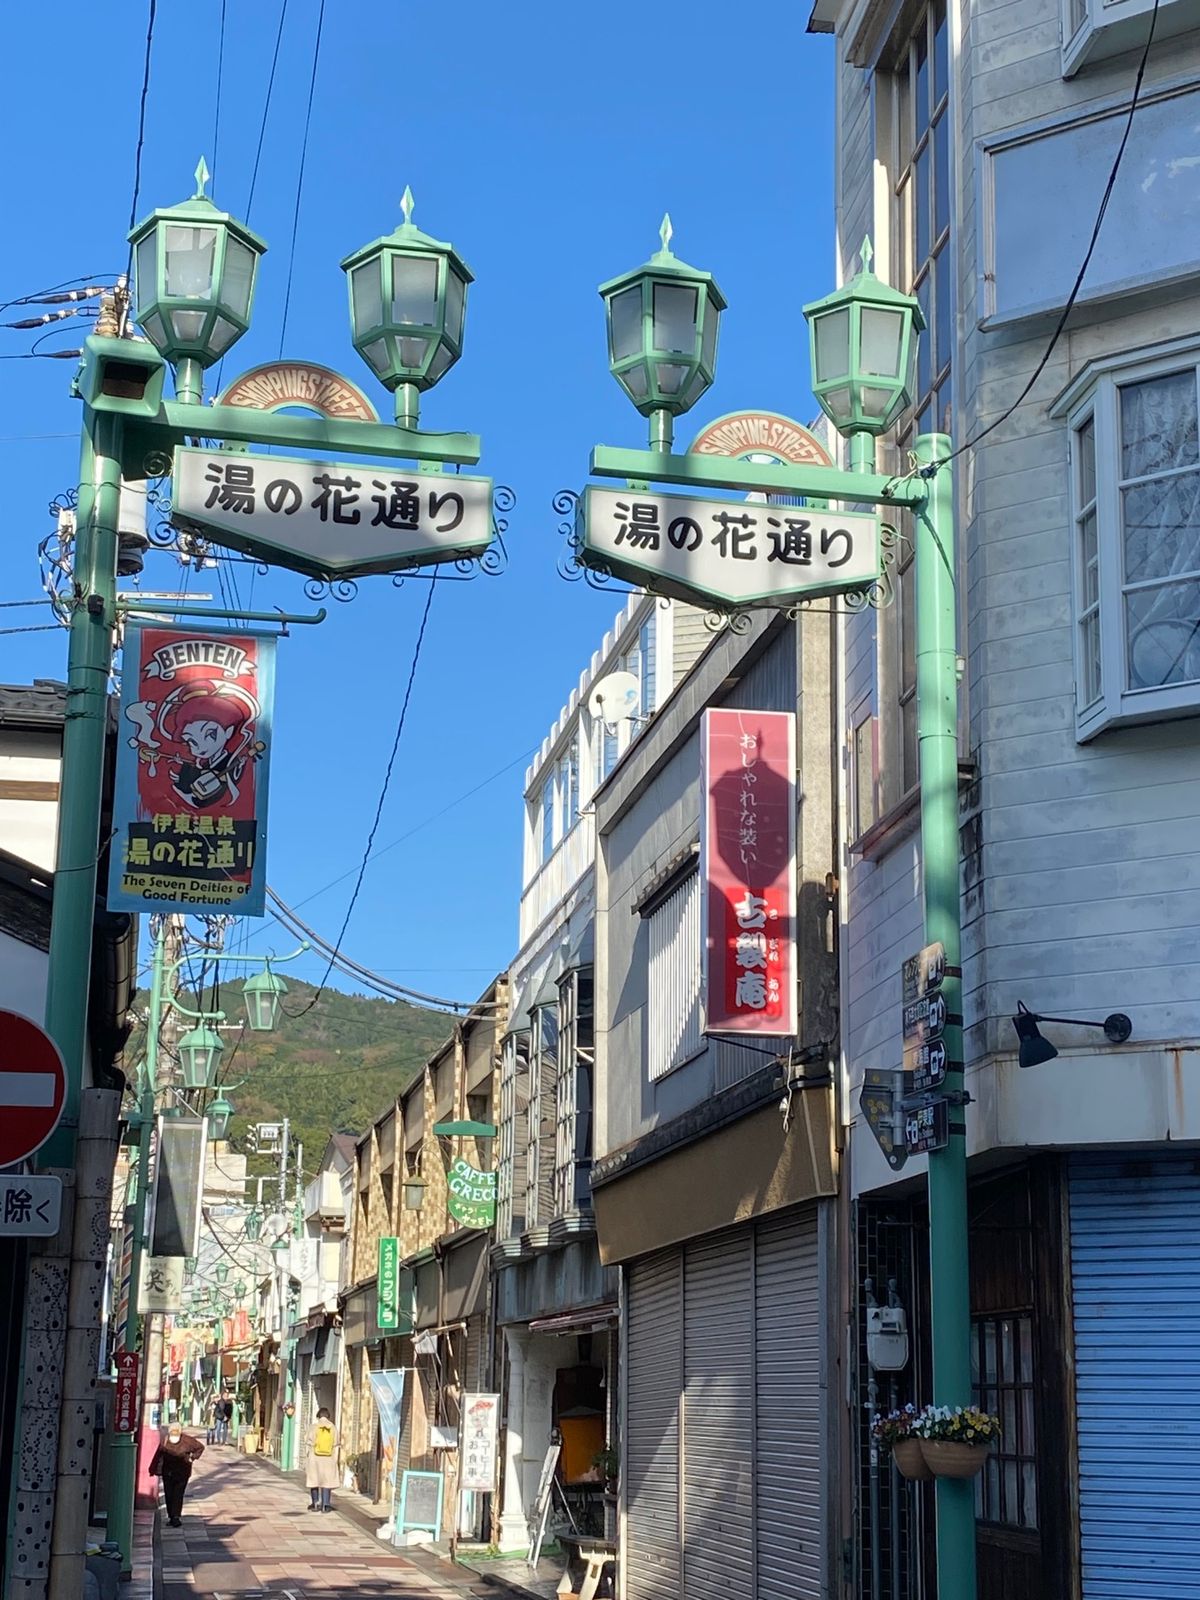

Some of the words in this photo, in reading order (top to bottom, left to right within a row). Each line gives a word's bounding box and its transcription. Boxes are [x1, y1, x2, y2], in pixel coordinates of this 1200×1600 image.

[230, 369, 310, 410] SHOPPING
[307, 372, 369, 422] STREET
[702, 419, 770, 456] SHOPPING
[768, 424, 824, 466] STREET
[204, 463, 465, 533] 湯の花通り
[613, 502, 854, 568] 湯の花通り
[158, 642, 242, 669] BENTEN
[740, 733, 757, 863] おしゃれな装い
[151, 813, 236, 836] 伊東温泉
[122, 837, 253, 869] 湯の花通り
[122, 874, 146, 887] The
[149, 876, 186, 890] Seven
[190, 881, 233, 894] Deities
[237, 884, 251, 895] of
[142, 888, 177, 902] Good
[180, 892, 231, 906] Fortune
[454, 1161, 496, 1186] CAFFE
[0, 1188, 50, 1224] 除く
[450, 1178, 498, 1202] GRECO
